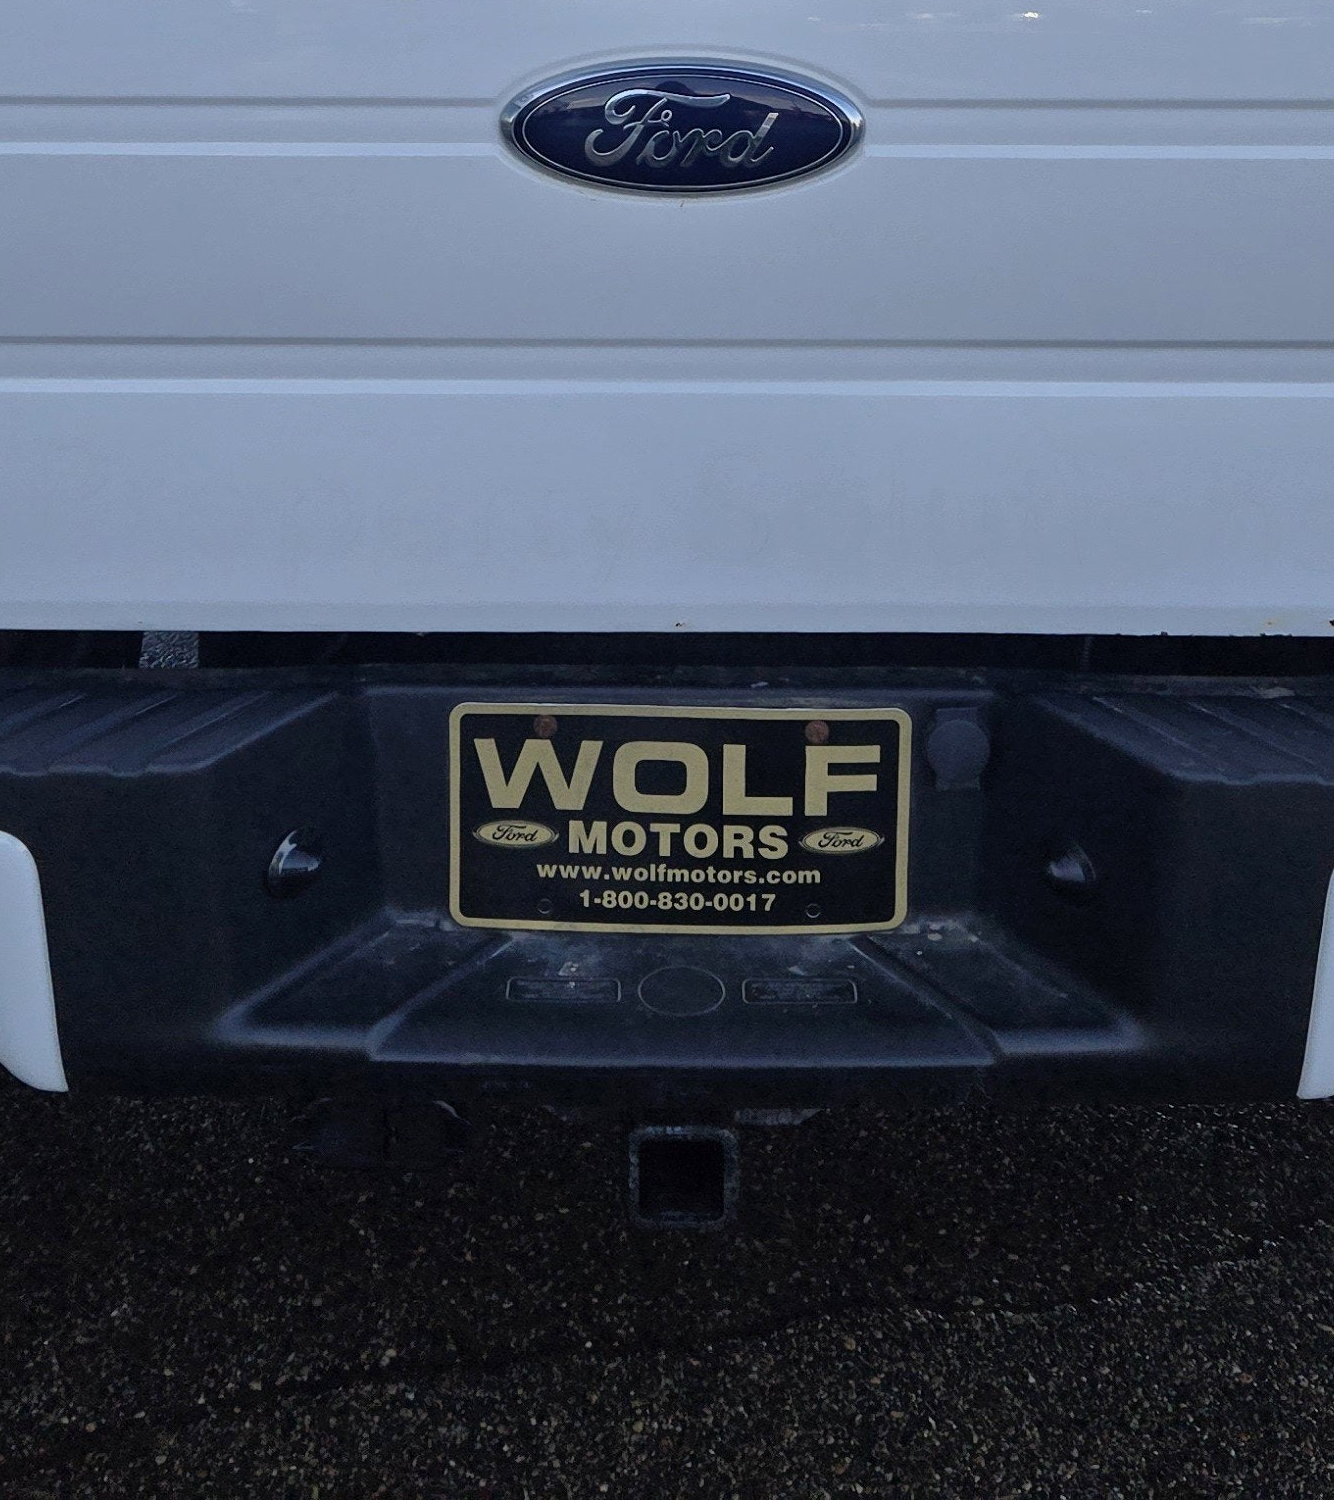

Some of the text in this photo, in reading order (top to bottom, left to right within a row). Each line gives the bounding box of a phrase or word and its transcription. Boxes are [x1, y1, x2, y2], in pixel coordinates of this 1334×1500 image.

[584, 88, 779, 166] Ford
[473, 738, 881, 816] WOLF
[491, 824, 539, 843] Ford
[568, 821, 789, 859] MOTORS
[817, 830, 865, 850] Ford
[537, 863, 822, 885] www.wolfmotors.com
[579, 890, 777, 912] 1-800-830-0017
